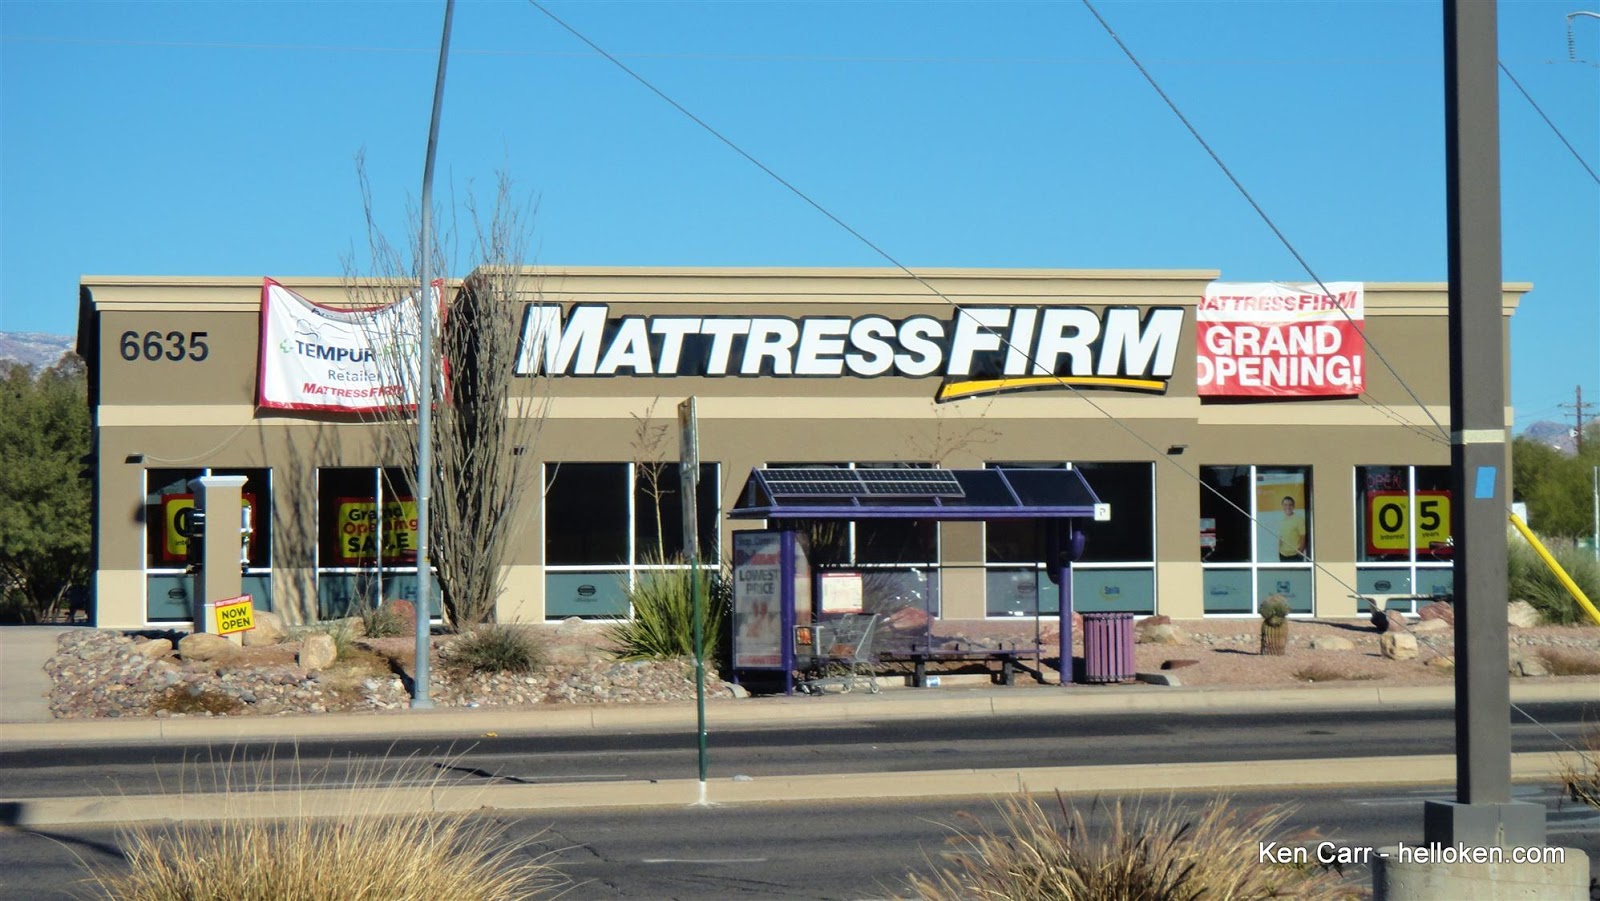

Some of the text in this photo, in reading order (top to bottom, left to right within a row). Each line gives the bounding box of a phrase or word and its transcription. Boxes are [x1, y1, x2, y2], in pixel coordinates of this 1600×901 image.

[119, 331, 209, 361] 6635
[1205, 325, 1342, 356] GRAND
[1197, 355, 1362, 387] OPENING!
[1420, 501, 1440, 531] 5
[739, 568, 778, 582] LOWEST
[745, 583, 775, 595] PRICE
[221, 606, 247, 620] NOW
[221, 617, 251, 630] OPEN
